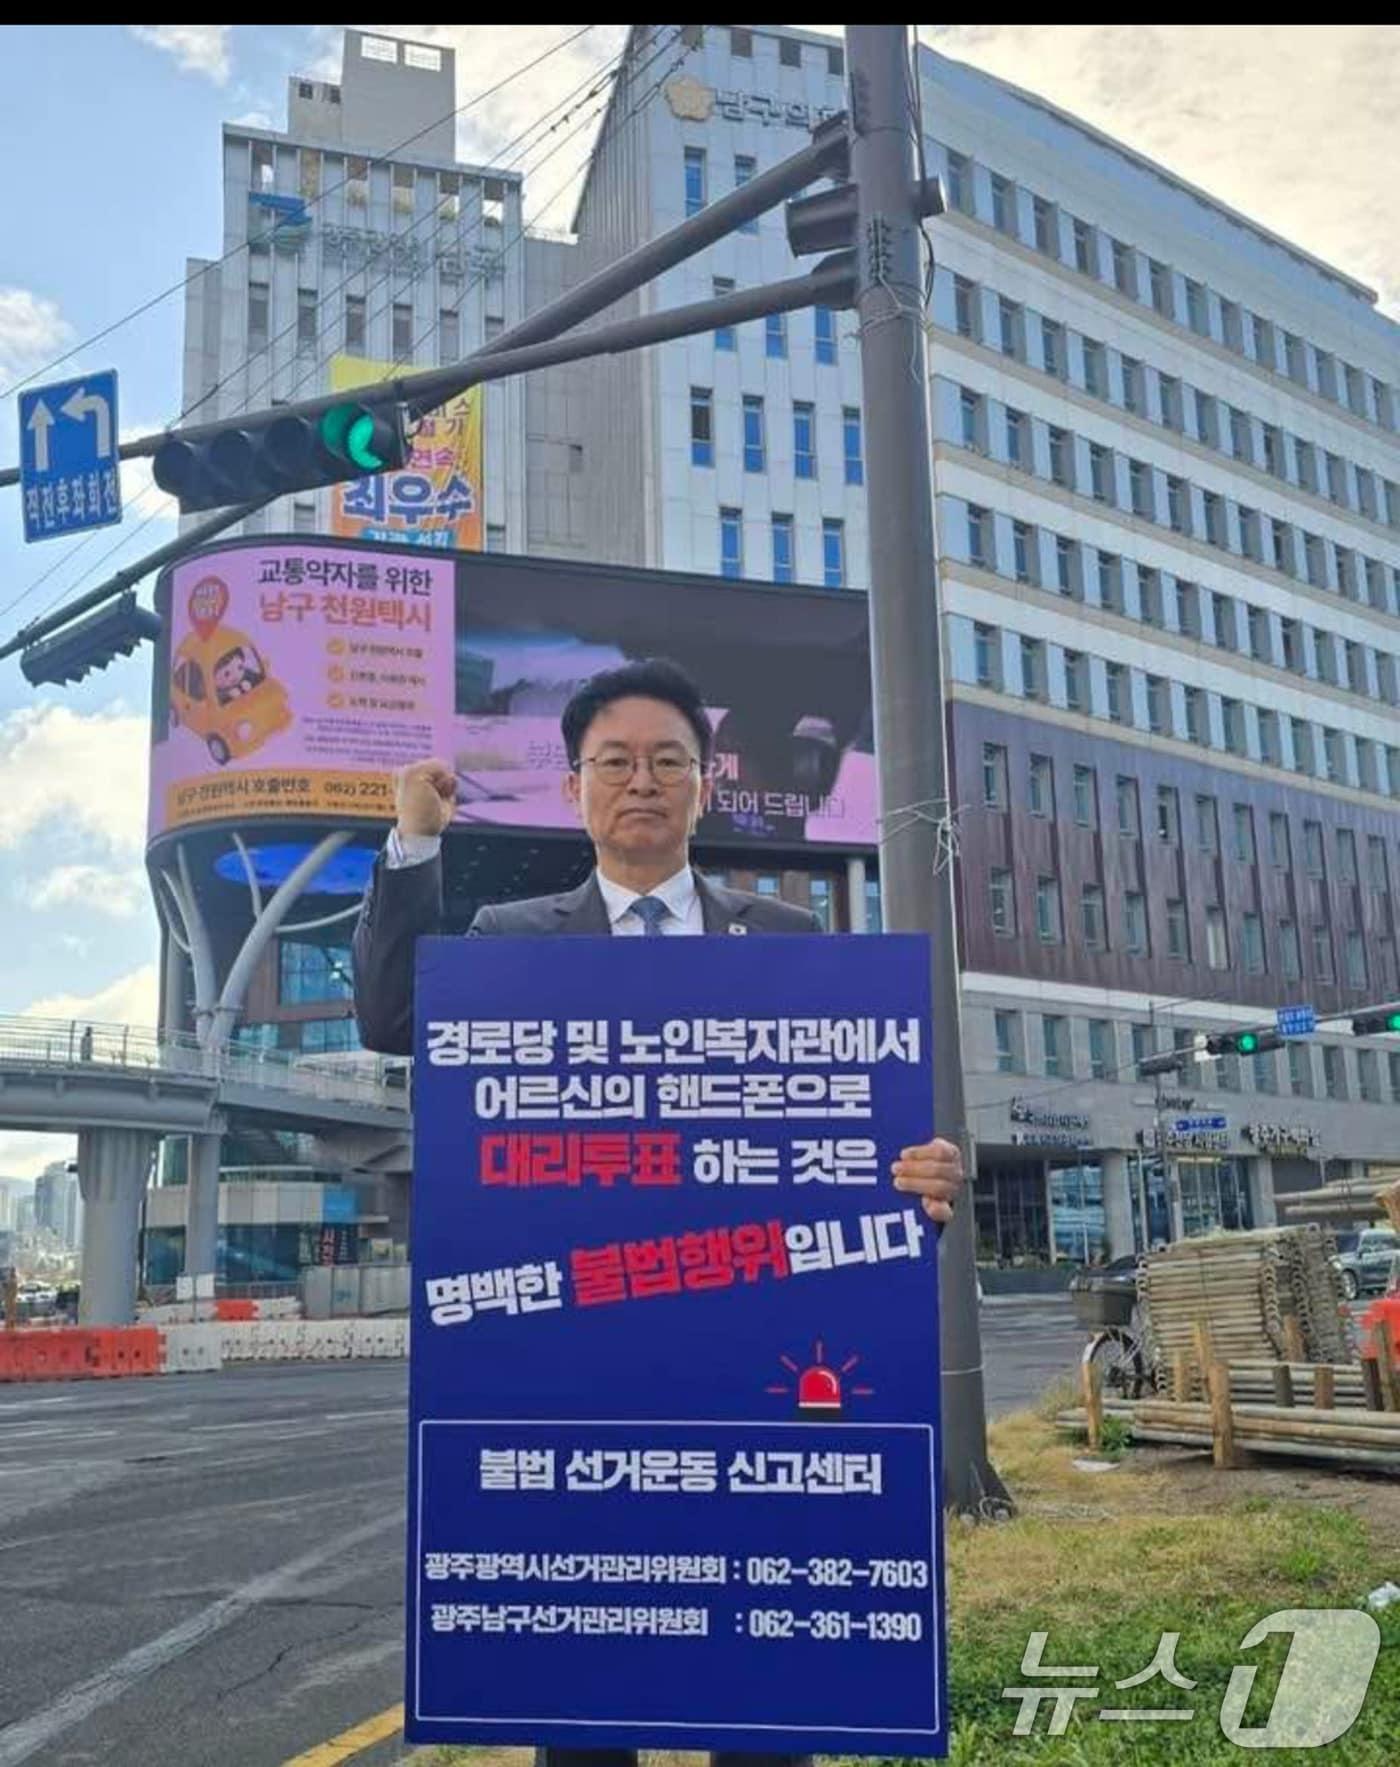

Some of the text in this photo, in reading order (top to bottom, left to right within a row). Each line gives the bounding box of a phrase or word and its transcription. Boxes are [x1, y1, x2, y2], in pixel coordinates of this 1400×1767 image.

[343, 474, 473, 525] 최우수
[258, 558, 432, 597] 교통약자를 위한
[260, 591, 315, 622] 남구
[322, 593, 431, 632] 천원택시
[253, 778, 311, 794] 호출번호
[324, 782, 356, 797] 062)
[360, 782, 393, 797] 221-
[717, 789, 759, 814] 되어
[764, 791, 845, 819] 드립니다
[426, 1018, 920, 1065] 경로당 및 노인복지관에서
[475, 1074, 871, 1119] 어르신의 핸드폰으로
[480, 1132, 877, 1186] 대리투표 하는 것은
[425, 1209, 924, 1327] 명백한 불법행위입니다
[480, 1449, 882, 1495] 불법 선거운동 신고센터
[425, 1552, 726, 1584] 광주광역시선거관리위원회
[746, 1558, 928, 1589] 062-382-7603
[430, 1604, 708, 1637] 광주남구선거관리위원회
[749, 1609, 922, 1642] 062-361-1390
